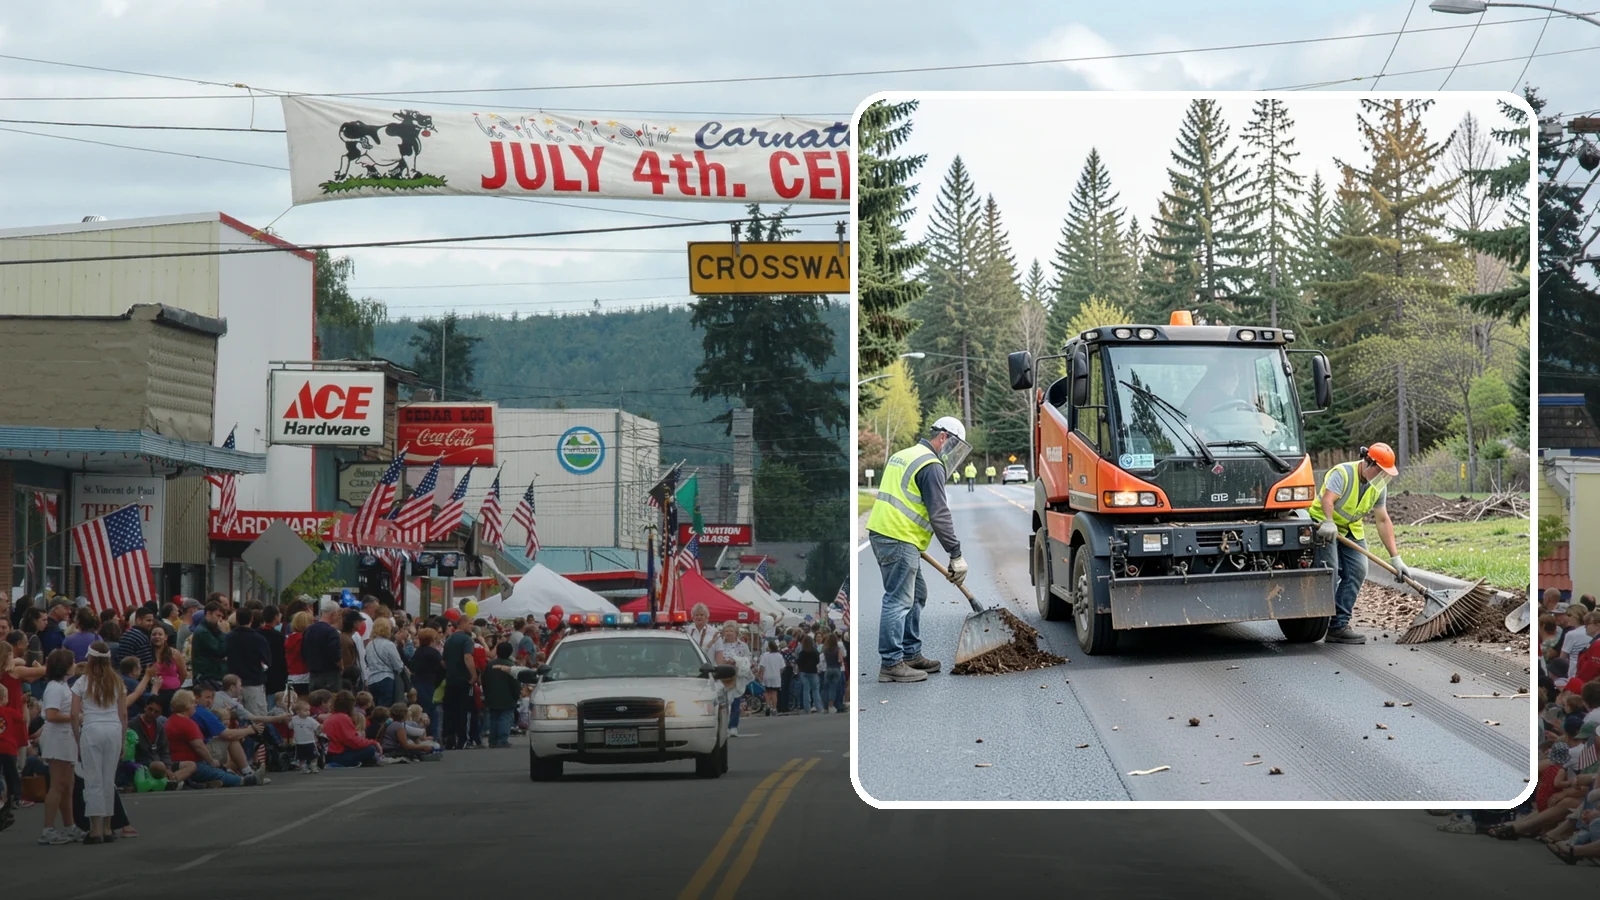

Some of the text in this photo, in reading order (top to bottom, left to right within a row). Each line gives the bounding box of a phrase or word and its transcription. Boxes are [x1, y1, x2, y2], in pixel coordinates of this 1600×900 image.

[481, 140, 604, 192] JULY
[632, 150, 746, 198] 4th.
[697, 254, 850, 280] CROSSWA
[283, 380, 373, 420] ACE
[405, 409, 453, 422] CEDAR
[283, 420, 370, 436] Hardware
[416, 427, 477, 447] Coca-Cola
[353, 467, 385, 480] Simpl
[83, 485, 155, 496] St. Vincent de Paul
[688, 526, 741, 535] CRNATION
[699, 535, 730, 544] GLASS
